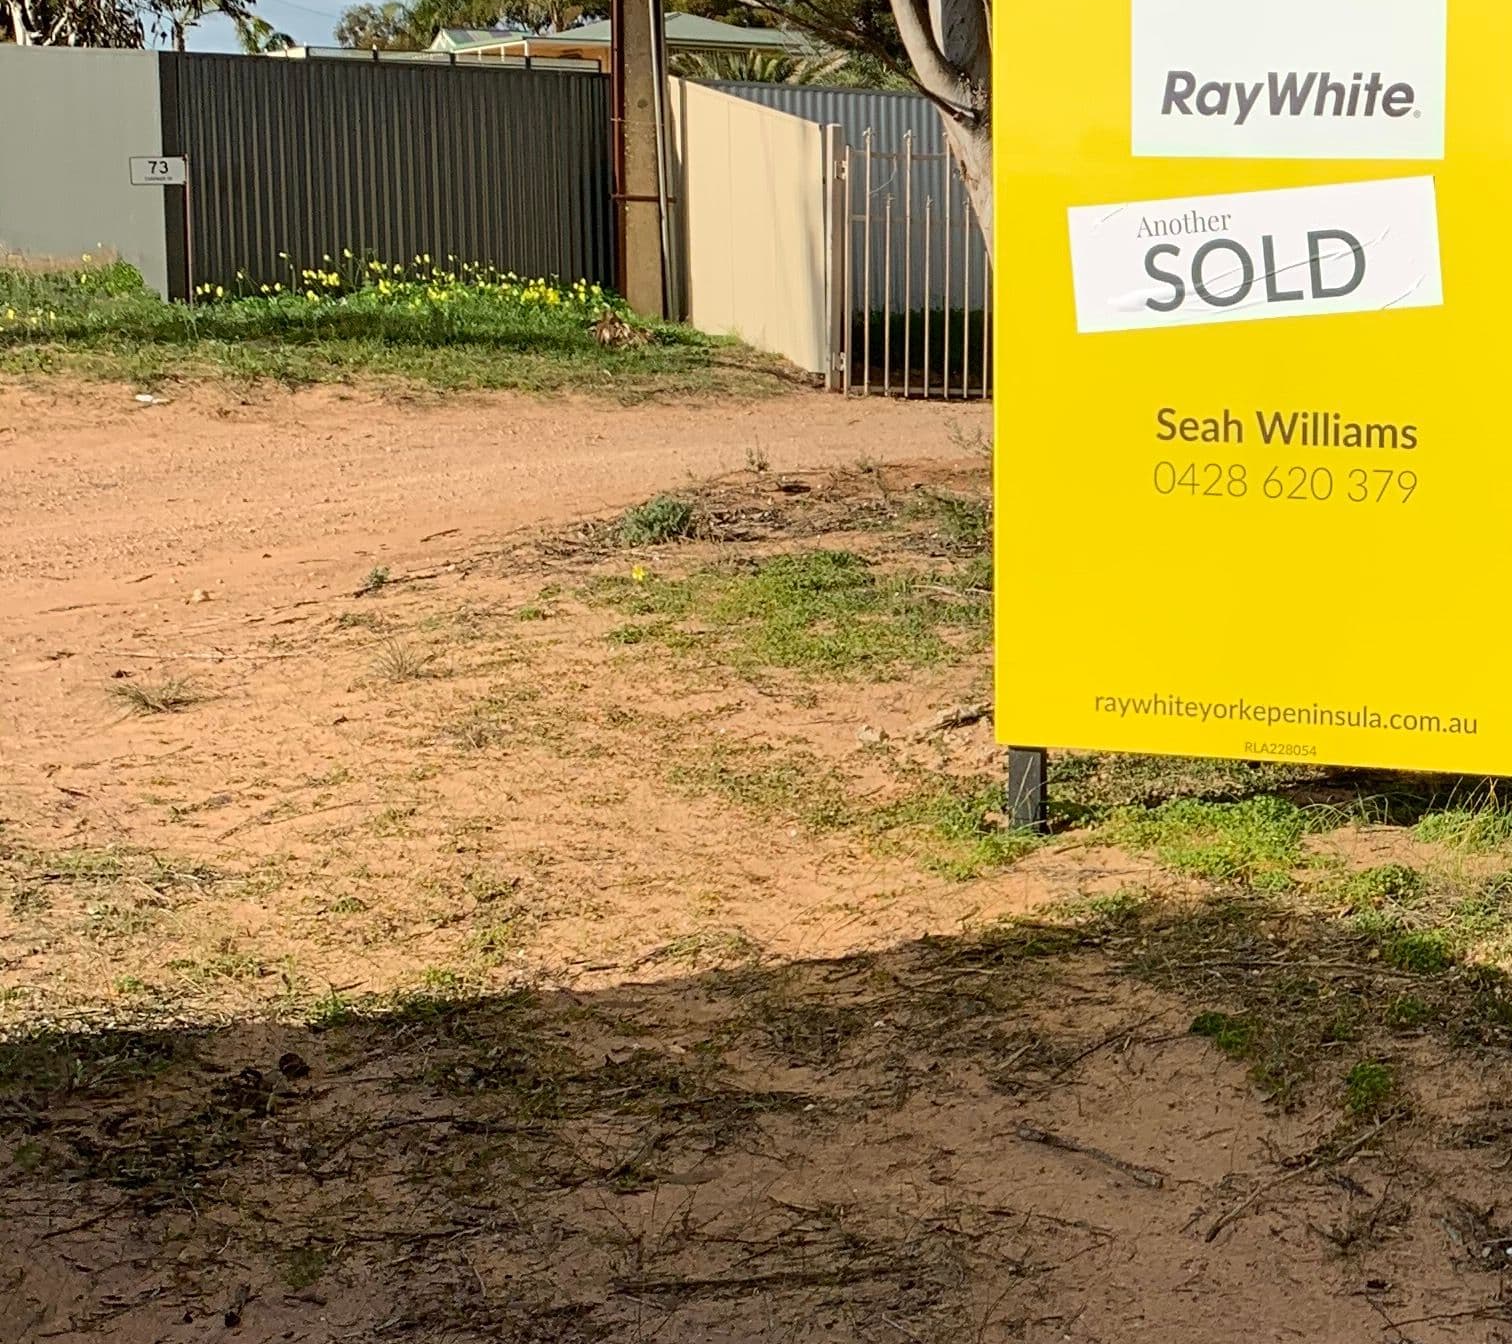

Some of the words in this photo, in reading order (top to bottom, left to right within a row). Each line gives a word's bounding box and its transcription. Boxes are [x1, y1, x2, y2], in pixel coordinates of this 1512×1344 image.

[148, 160, 169, 174] 73
[1136, 209, 1232, 238] Another
[1144, 228, 1366, 312] SOLD
[1156, 407, 1243, 444] Seah
[1256, 410, 1418, 450] Williams
[1154, 460, 1248, 498] 0428
[1262, 465, 1334, 501] 620
[1347, 468, 1418, 504] 379
[1095, 692, 1478, 735] raywhiteyorkepeninsula.com.au
[1244, 741, 1318, 757] RLA228054
